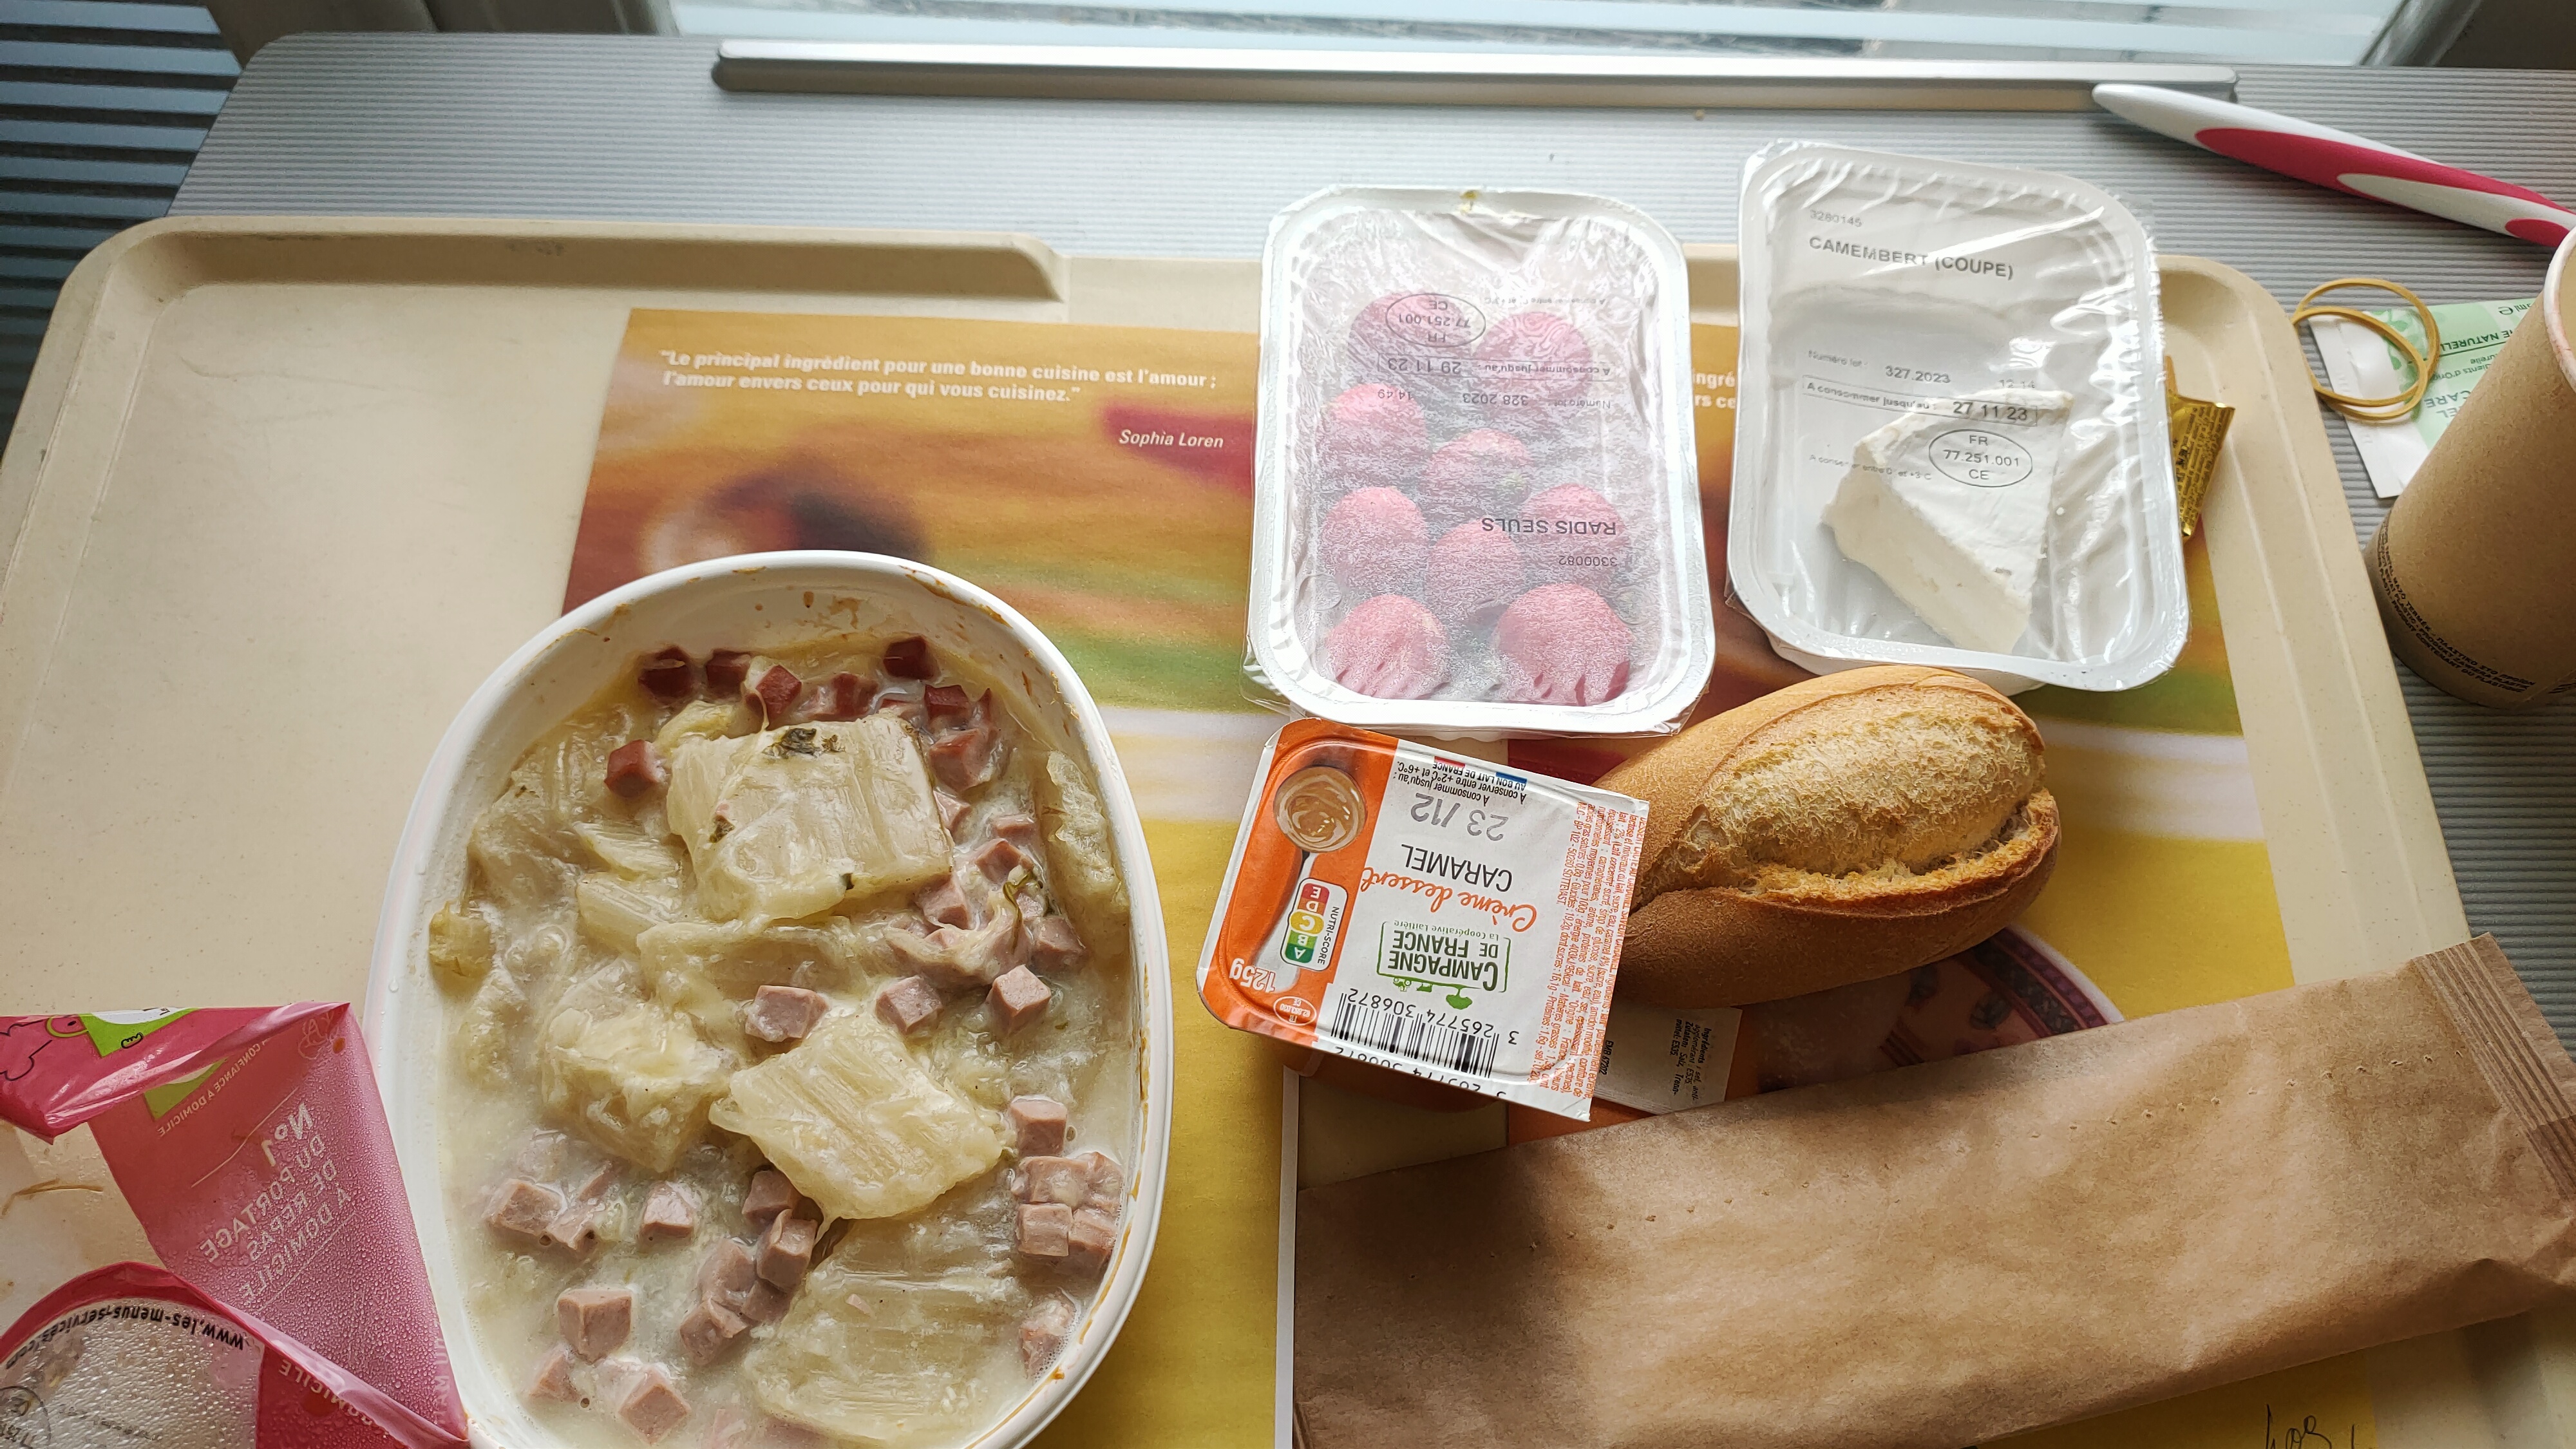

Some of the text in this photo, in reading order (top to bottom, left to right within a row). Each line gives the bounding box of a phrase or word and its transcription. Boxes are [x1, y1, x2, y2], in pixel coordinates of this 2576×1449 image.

[1810, 237, 2014, 280] CAMEMBERT (COUPE)
[1428, 299, 1448, 310] CE
[1397, 314, 1471, 328] 77.251.001
[1426, 332, 1446, 343] FR
[2439, 331, 2499, 352] NATURELL
[694, 351, 779, 370] principal
[784, 354, 880, 372] ingrédient
[884, 361, 927, 375] pour
[931, 362, 965, 375] une
[971, 360, 1027, 378] bonne
[1032, 364, 1099, 381] cuisine
[1105, 369, 1133, 383] est
[1138, 369, 1206, 387] l'amour
[1387, 358, 1610, 376] A consommer jusqu'au 29 11 23
[1885, 366, 1951, 384] 327.2023
[663, 370, 735, 386] l'amour
[739, 376, 802, 390] envers
[807, 377, 853, 392] ceux
[857, 379, 901, 396] pour
[905, 379, 934, 399] qui
[940, 384, 983, 398] vous
[1462, 392, 1528, 406] 328.2023
[1817, 386, 1880, 402] consommer
[1953, 401, 1973, 415] 27
[1982, 404, 1998, 417] 11
[2007, 407, 2027, 421] 23
[2423, 389, 2472, 408] CARE
[1119, 430, 1223, 448] Sophia Loren
[1970, 435, 1988, 446] FR
[1943, 449, 2019, 466] 77.251.001
[1969, 469, 1989, 480] CE
[1481, 518, 1616, 535] RADIS SEULS
[1558, 555, 1617, 565] 3300082
[1397, 769, 1434, 791] jusqu'au
[1421, 768, 1430, 776] et
[1431, 770, 1454, 784] +2°C
[1432, 761, 1526, 791] AU BON LAIT DE FRANCE
[1455, 777, 1477, 788] entre
[1477, 782, 1518, 799] conserver
[1434, 782, 1481, 801] consommer
[1464, 808, 1508, 843] 23
[1582, 823, 1591, 837] gras
[1614, 828, 1624, 840] 2%
[1564, 820, 1582, 867] BP 102 50260
[1396, 843, 1514, 893] CARAMEL
[1583, 848, 1598, 879] moyennes
[1617, 873, 1627, 882] du
[1311, 886, 1321, 898] E
[1567, 882, 1581, 909] Glucides
[1579, 880, 1590, 895] pour
[1305, 899, 1318, 911] D
[1358, 865, 1539, 935] Crème dessert
[1575, 896, 1589, 913] 100g
[1300, 914, 1316, 927] C
[1596, 908, 1609, 924] sirop
[1394, 920, 1428, 931] Laitière
[1431, 923, 1486, 940] Coopérative
[1569, 918, 1585, 942] énergie
[1595, 925, 1605, 935] de
[1296, 933, 1308, 945] B
[1316, 906, 1339, 965] NUTRI-SCORE
[1391, 929, 1499, 958] DE FRANCE
[1558, 931, 1569, 946] dont
[1575, 906, 1598, 976] arôme, protéines de
[1602, 929, 1615, 954] caramel
[1292, 946, 1305, 960] A
[1554, 946, 1565, 968] sucres
[1587, 936, 1603, 963] glucose,
[1386, 947, 1499, 992] CAMPAGNE
[1599, 955, 1610, 967] 4%
[1227, 956, 1279, 994] 125g
[1547, 971, 1562, 991] 16,1g
[1346, 985, 1416, 1019] 306872
[1553, 992, 1568, 1022] Matières
[1542, 996, 1557, 1027] Protéines
[1586, 1005, 1599, 1030] amidon
[1423, 1005, 1494, 1039] 265774
[1506, 1029, 1520, 1045] 3
[1535, 1029, 1549, 1045] 1,6g
[1546, 1022, 1561, 1048] grasses
[1534, 1050, 1546, 1061] sel
[1603, 1039, 1613, 1055] EMB
[1572, 1088, 1582, 1097] de
